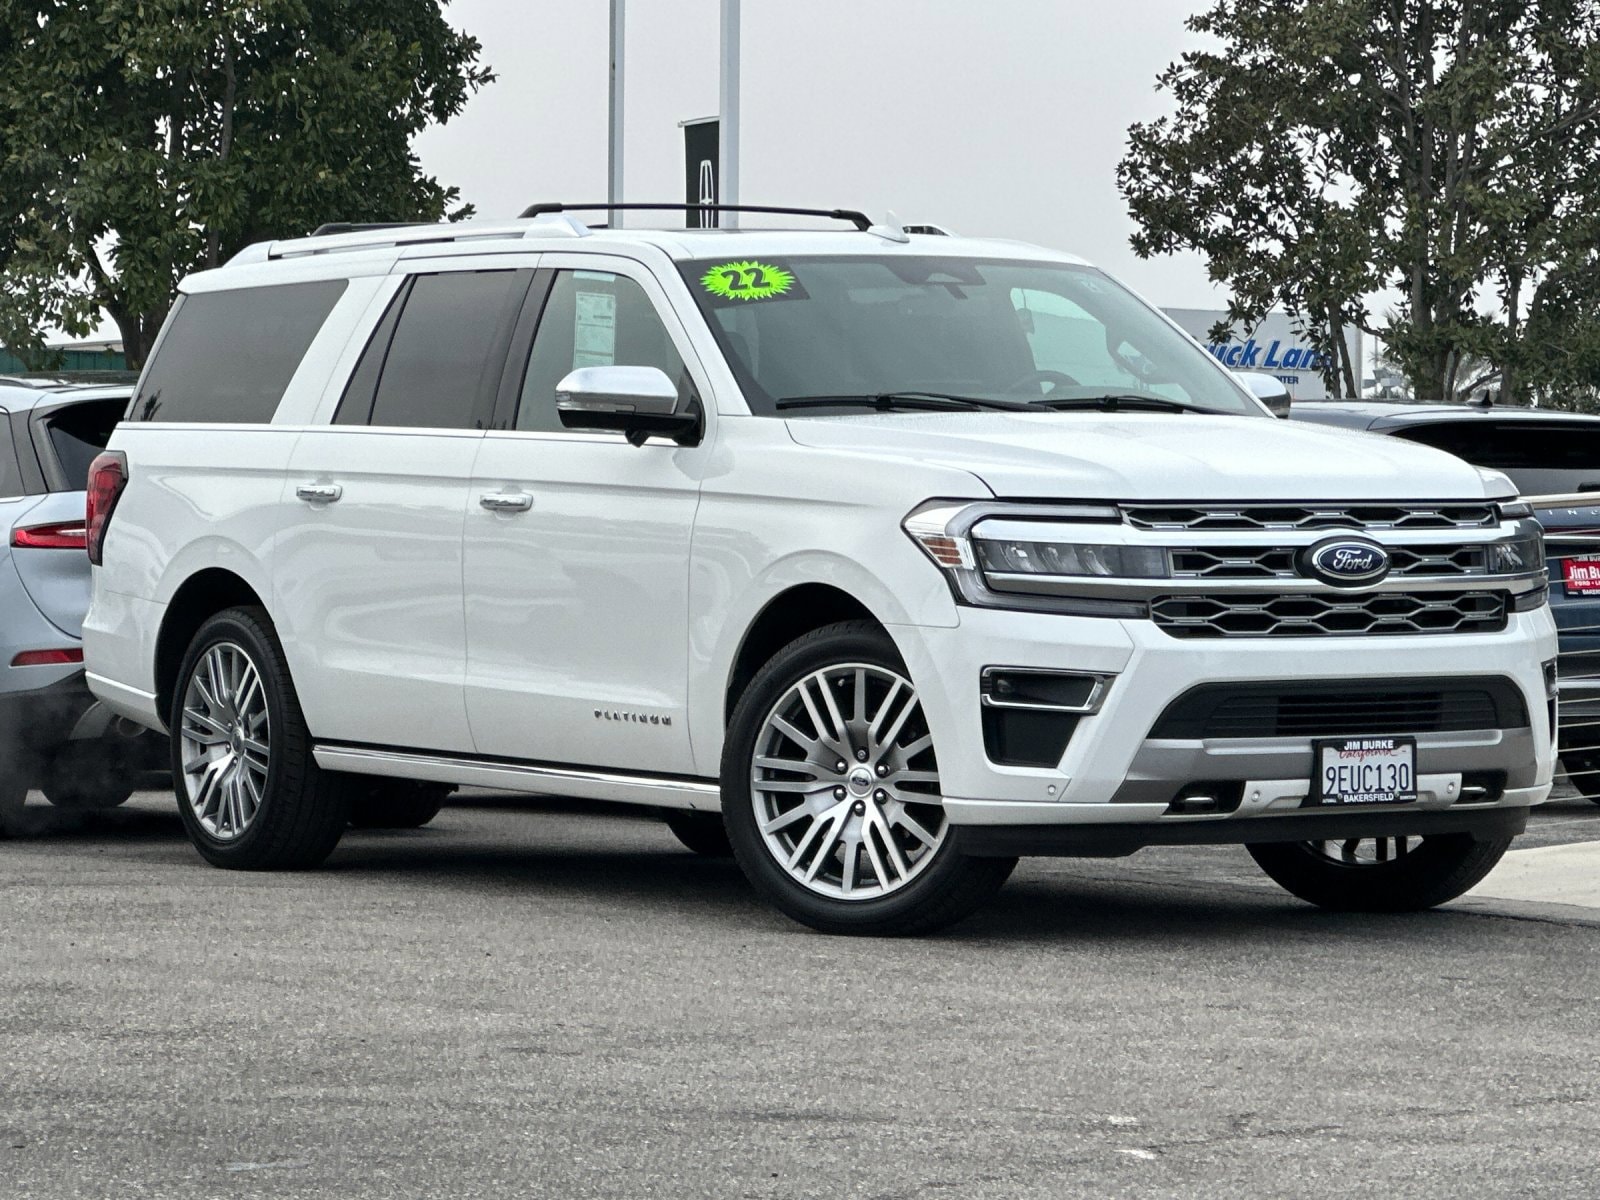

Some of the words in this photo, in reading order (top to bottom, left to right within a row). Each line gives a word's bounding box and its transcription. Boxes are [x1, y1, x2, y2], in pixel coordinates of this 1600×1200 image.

[721, 267, 771, 291] 22
[1333, 549, 1373, 570] Ford
[1569, 566, 1589, 580] Jim
[594, 708, 672, 726] PLATINUM
[1344, 741, 1360, 751] JIM
[1362, 740, 1394, 750] BURKE
[1325, 763, 1409, 795] 9EUC130
[1343, 793, 1394, 803] BAKERSFIELD
